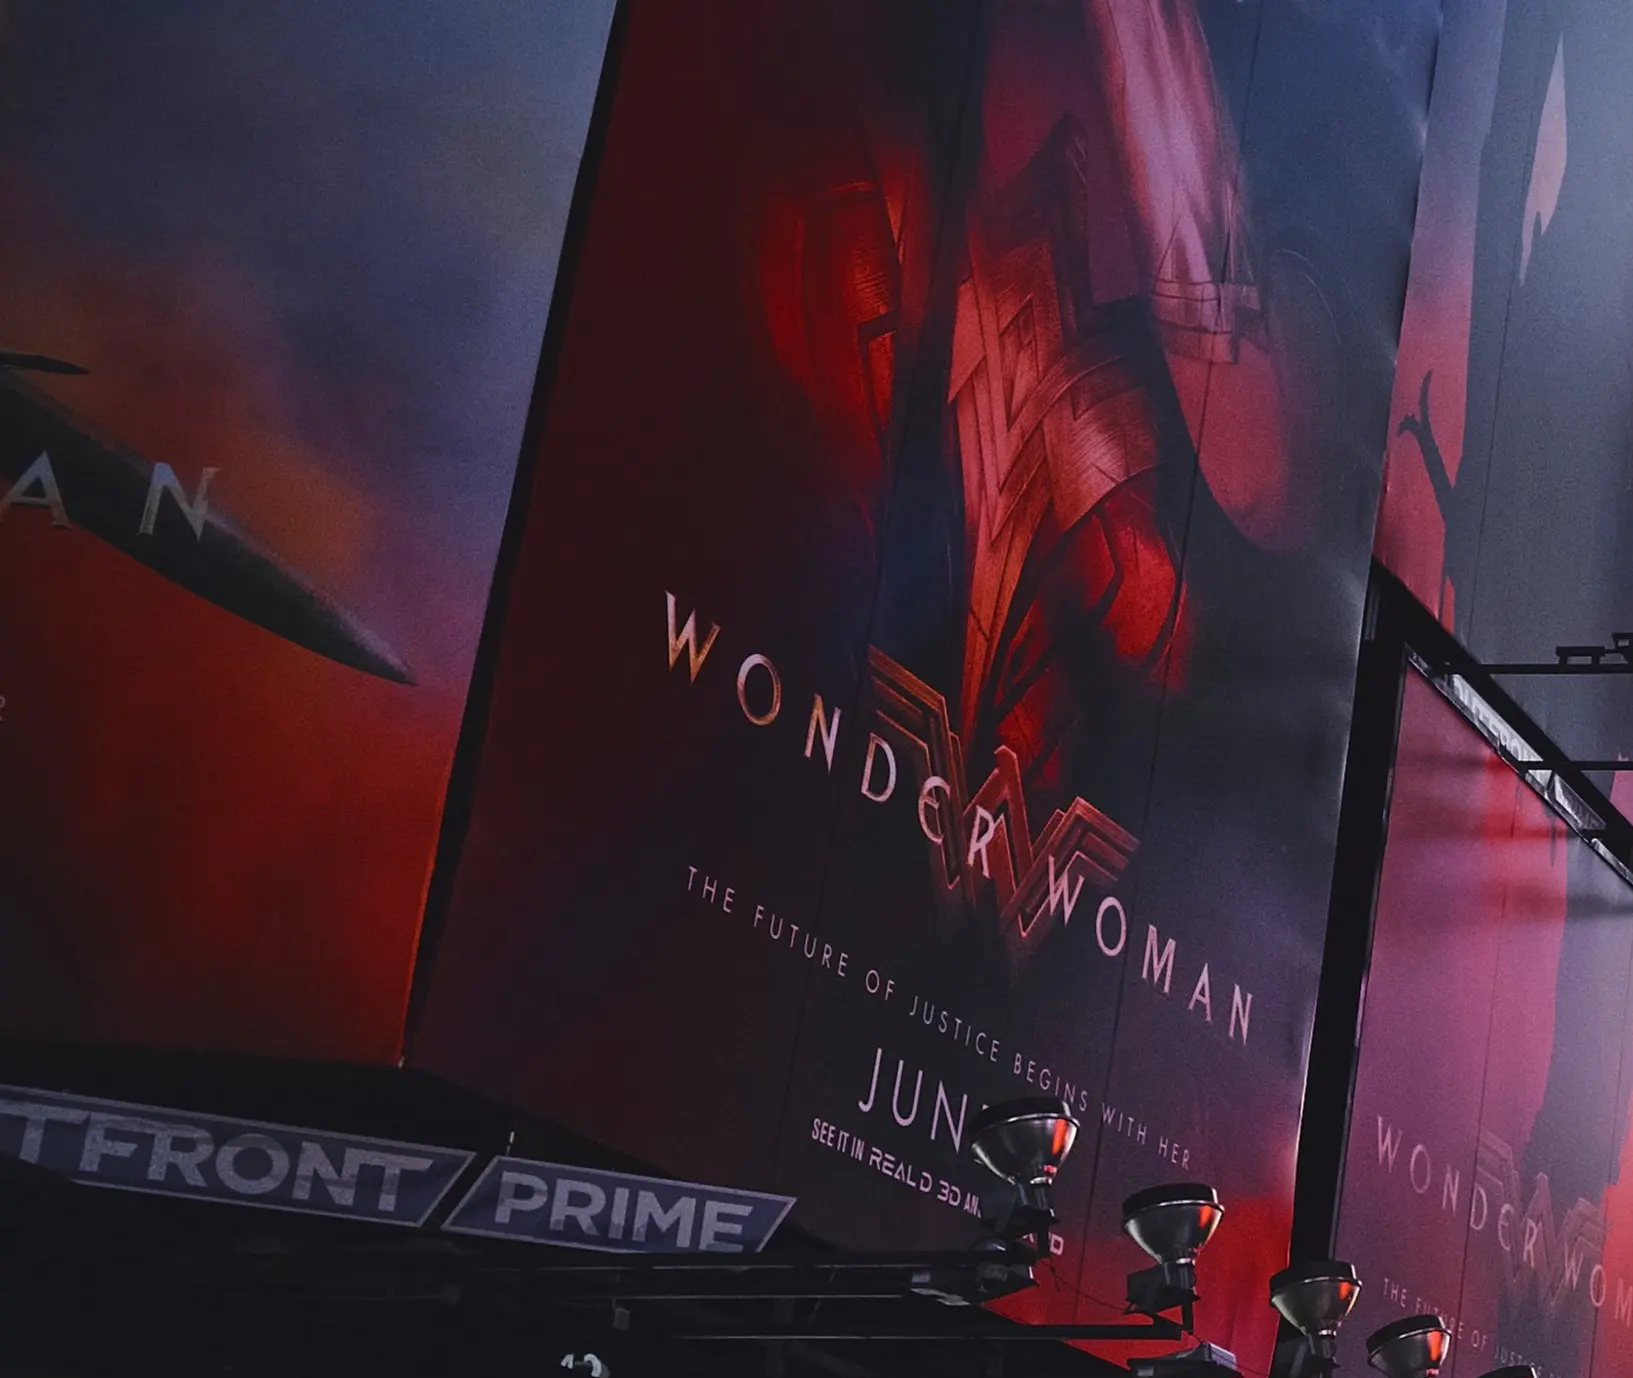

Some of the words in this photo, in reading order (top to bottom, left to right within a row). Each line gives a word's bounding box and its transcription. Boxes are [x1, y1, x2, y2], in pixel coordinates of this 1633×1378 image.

[665, 591, 1000, 881] WONDER
[1047, 854, 1253, 1046] WOMAN
[685, 866, 735, 913] THE
[753, 904, 850, 979] FUTURE
[865, 968, 897, 1002] OF
[909, 995, 1001, 1062] JUSTICE
[1013, 1052, 1089, 1112] BEGINS
[1101, 1102, 1148, 1146] WITH
[1158, 1133, 1192, 1170] HER
[858, 1047, 990, 1154] JUN
[494, 1170, 756, 1254] PRIME
[812, 1117, 836, 1147] SEE
[836, 1128, 849, 1150] IT
[850, 1136, 864, 1162] IN
[936, 1179, 962, 1206] 3D
[1375, 1114, 1540, 1269] WONDER
[1383, 1278, 1408, 1309] THE
[1470, 1329, 1488, 1350] OF
